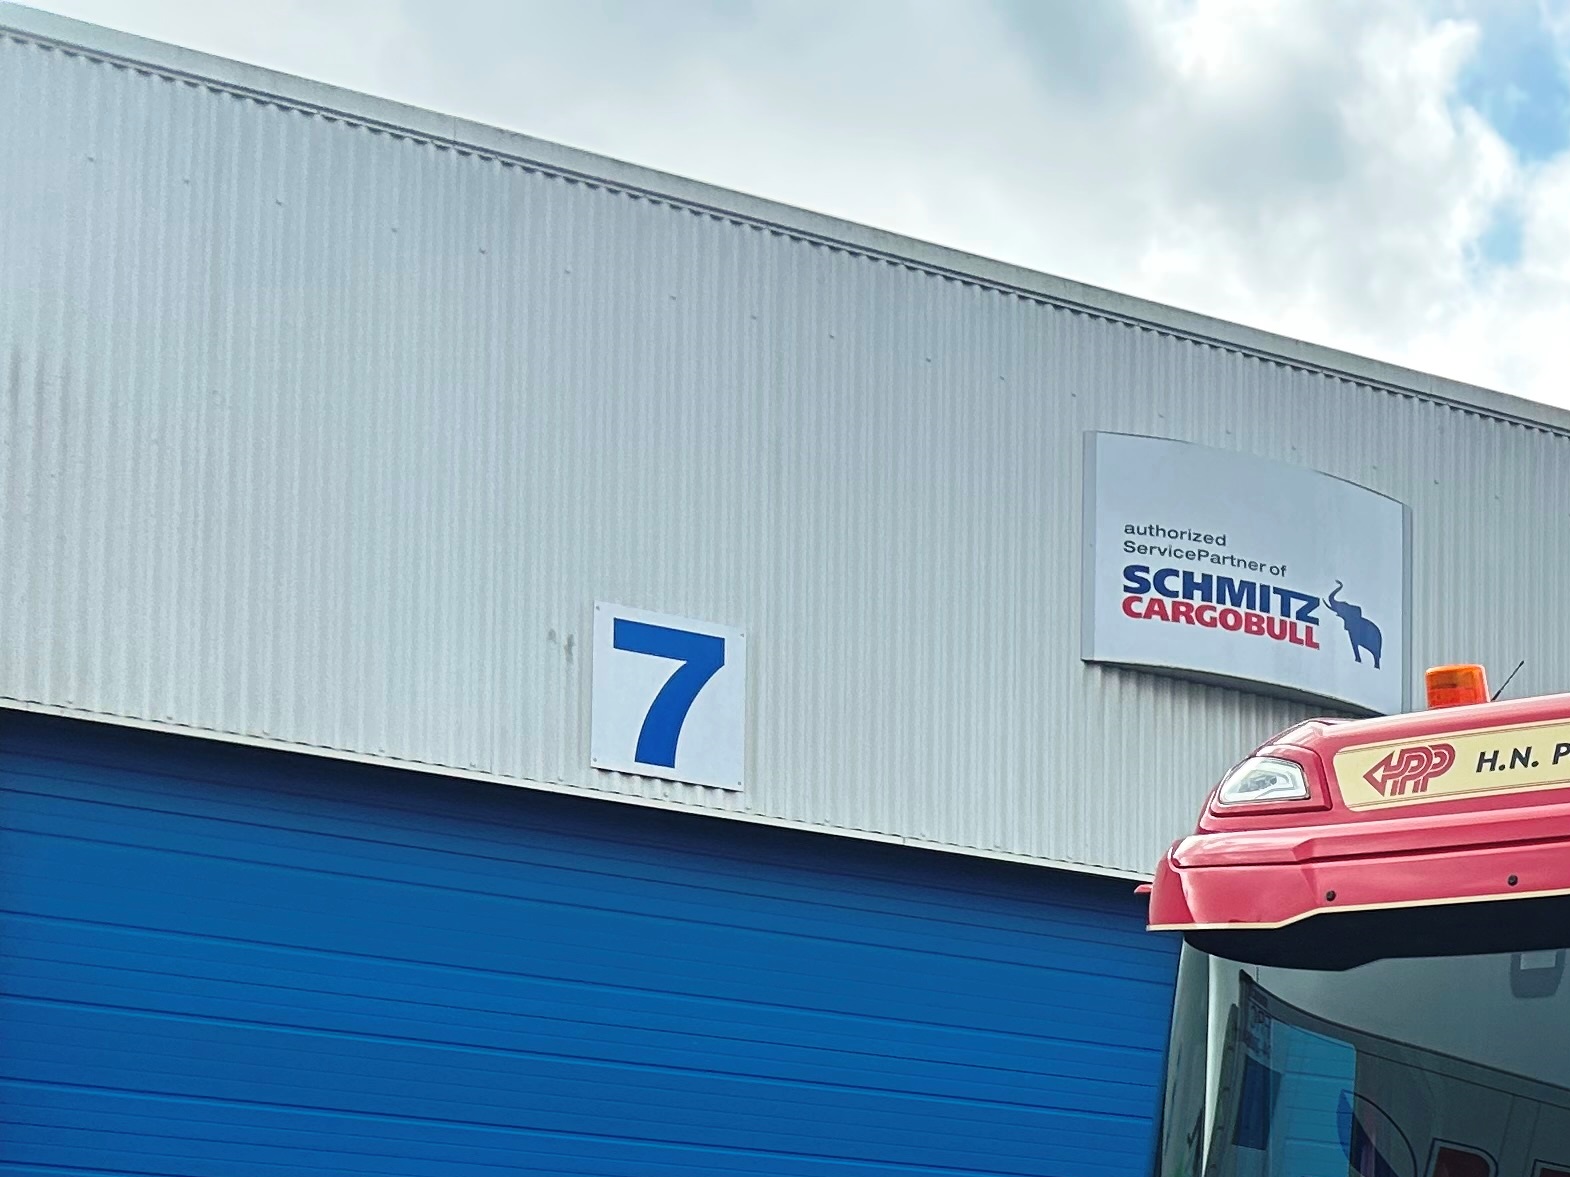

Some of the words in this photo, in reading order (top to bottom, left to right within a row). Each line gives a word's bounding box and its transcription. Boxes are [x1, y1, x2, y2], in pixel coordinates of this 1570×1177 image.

[1124, 524, 1227, 547] authorized
[1123, 540, 1267, 573] ServicePartner
[1269, 564, 1288, 577] of
[1122, 564, 1320, 626] SCHMITZ
[1122, 596, 1320, 650] CARGOBULL
[613, 617, 725, 769] 7
[1476, 746, 1539, 773] H.N.
